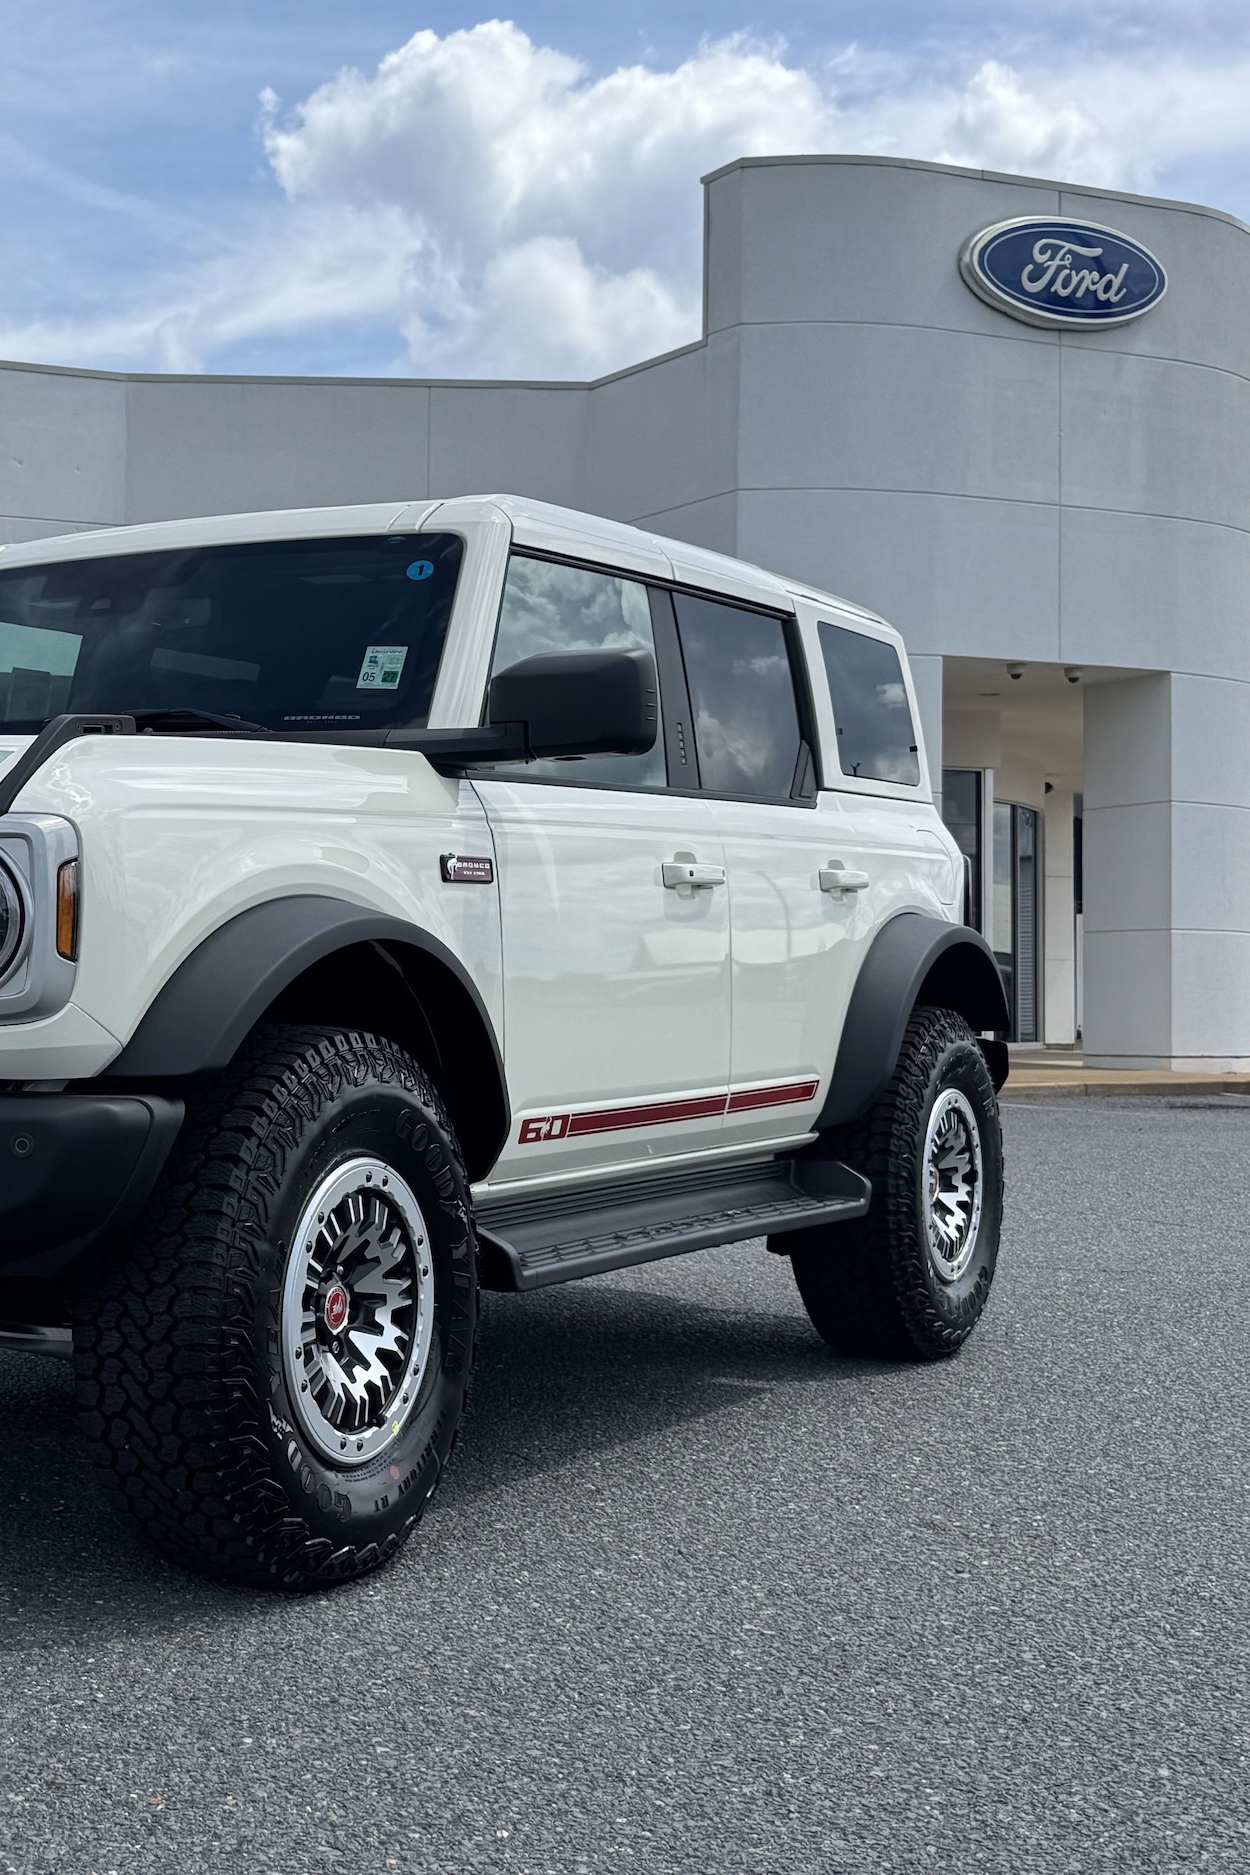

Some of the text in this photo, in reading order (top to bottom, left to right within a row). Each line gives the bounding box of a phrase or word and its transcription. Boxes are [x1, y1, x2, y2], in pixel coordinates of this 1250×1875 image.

[1021, 238, 1129, 303] Ford
[362, 671, 397, 682] 05 27
[456, 861, 490, 869] BRONCO
[518, 1114, 570, 1144] 60
[395, 1109, 471, 1374] GOODYEAR
[374, 1494, 390, 1512] RT
